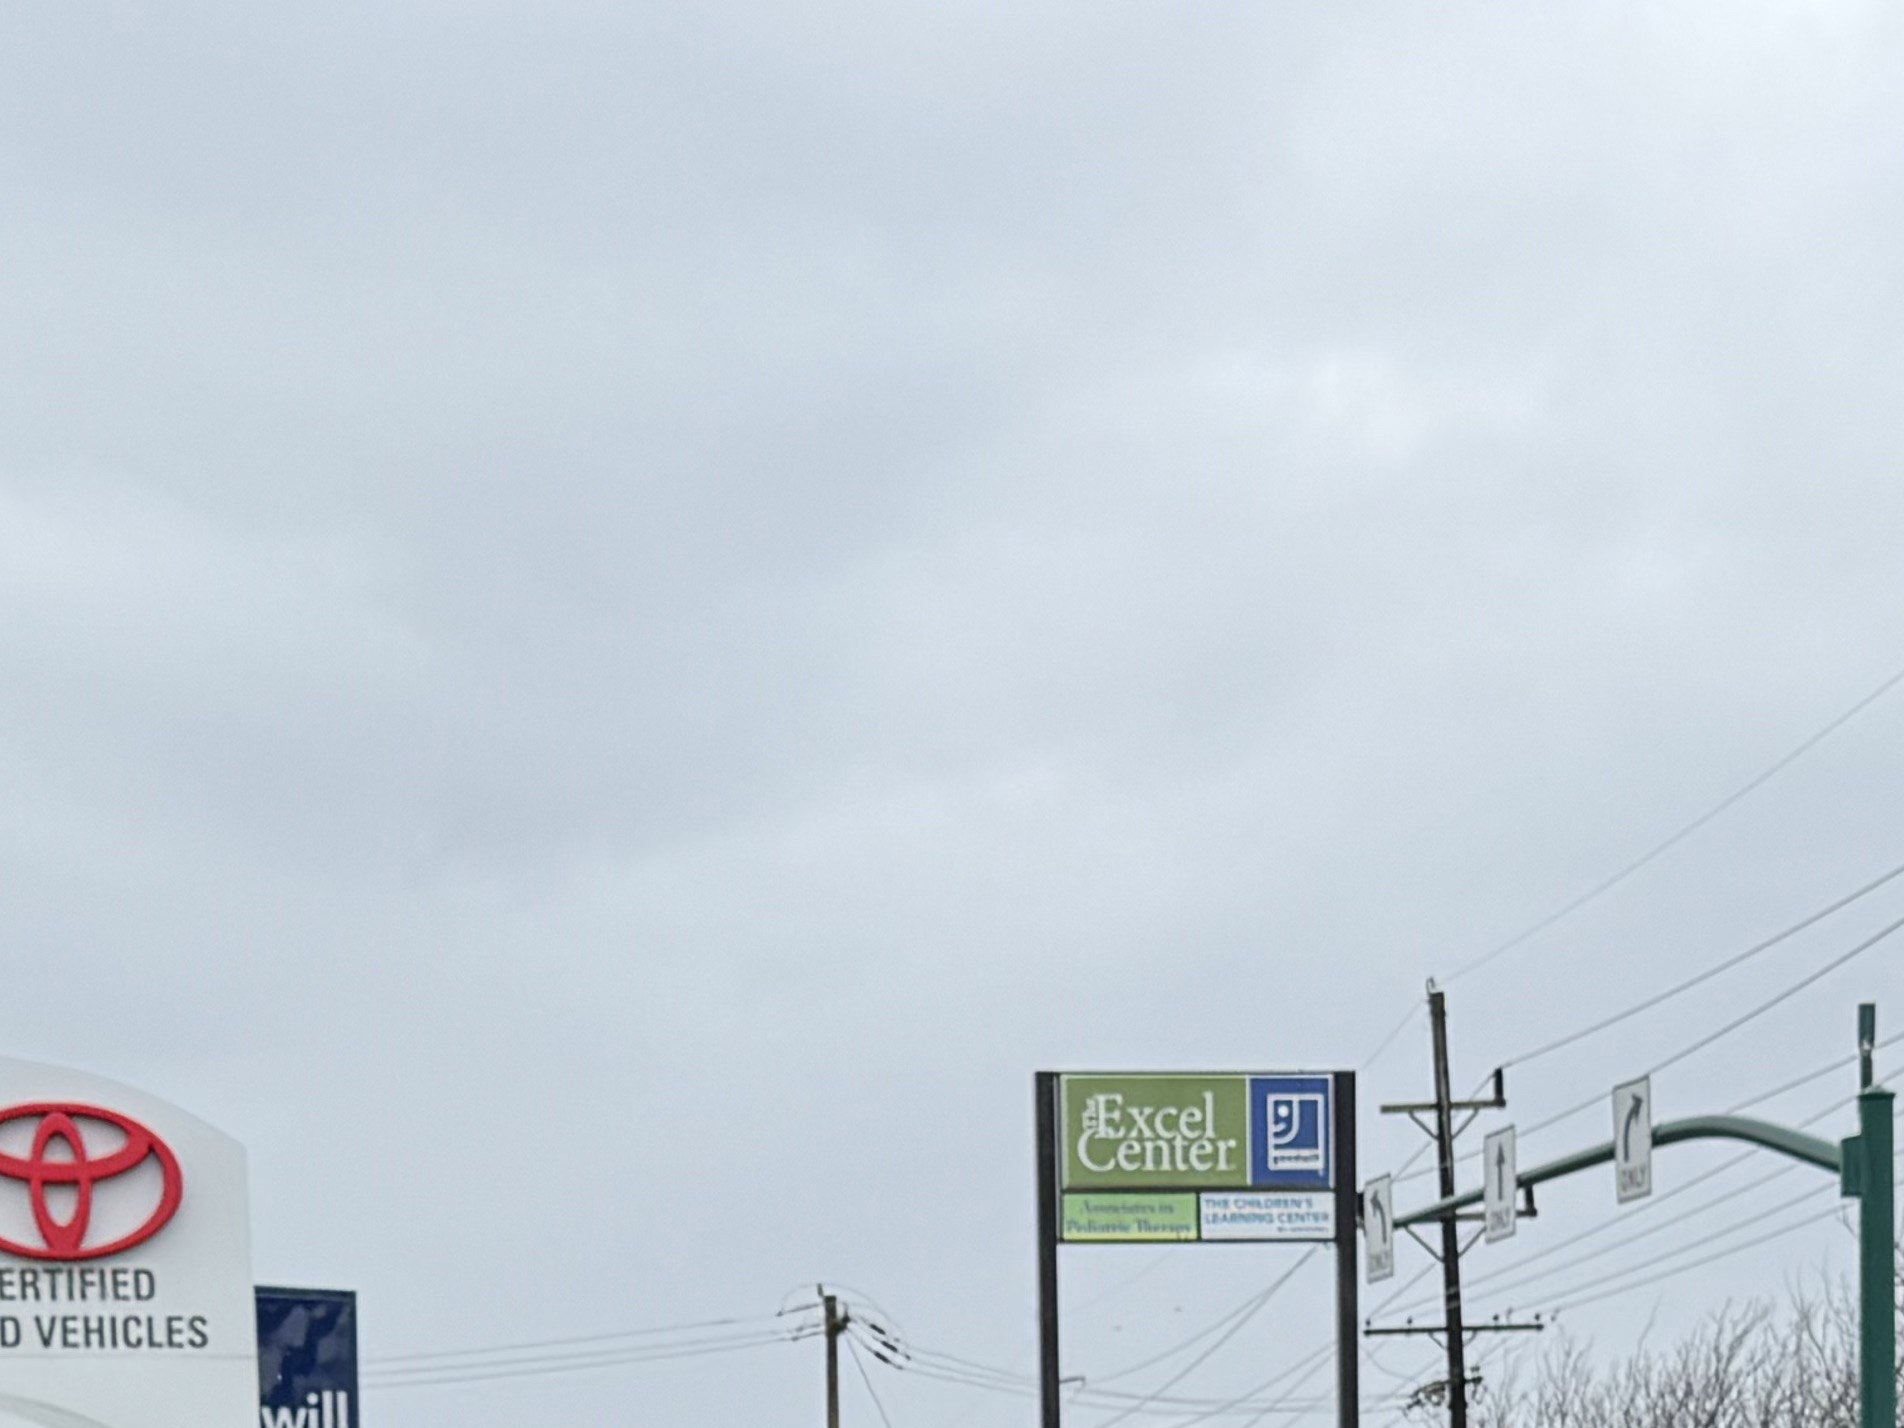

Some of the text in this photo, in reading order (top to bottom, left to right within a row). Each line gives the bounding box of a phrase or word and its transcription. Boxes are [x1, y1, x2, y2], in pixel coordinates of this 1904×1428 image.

[1094, 1091, 1217, 1139] Excel
[1077, 1128, 1237, 1171] Center
[36, 1316, 209, 1349] VEHICLES
